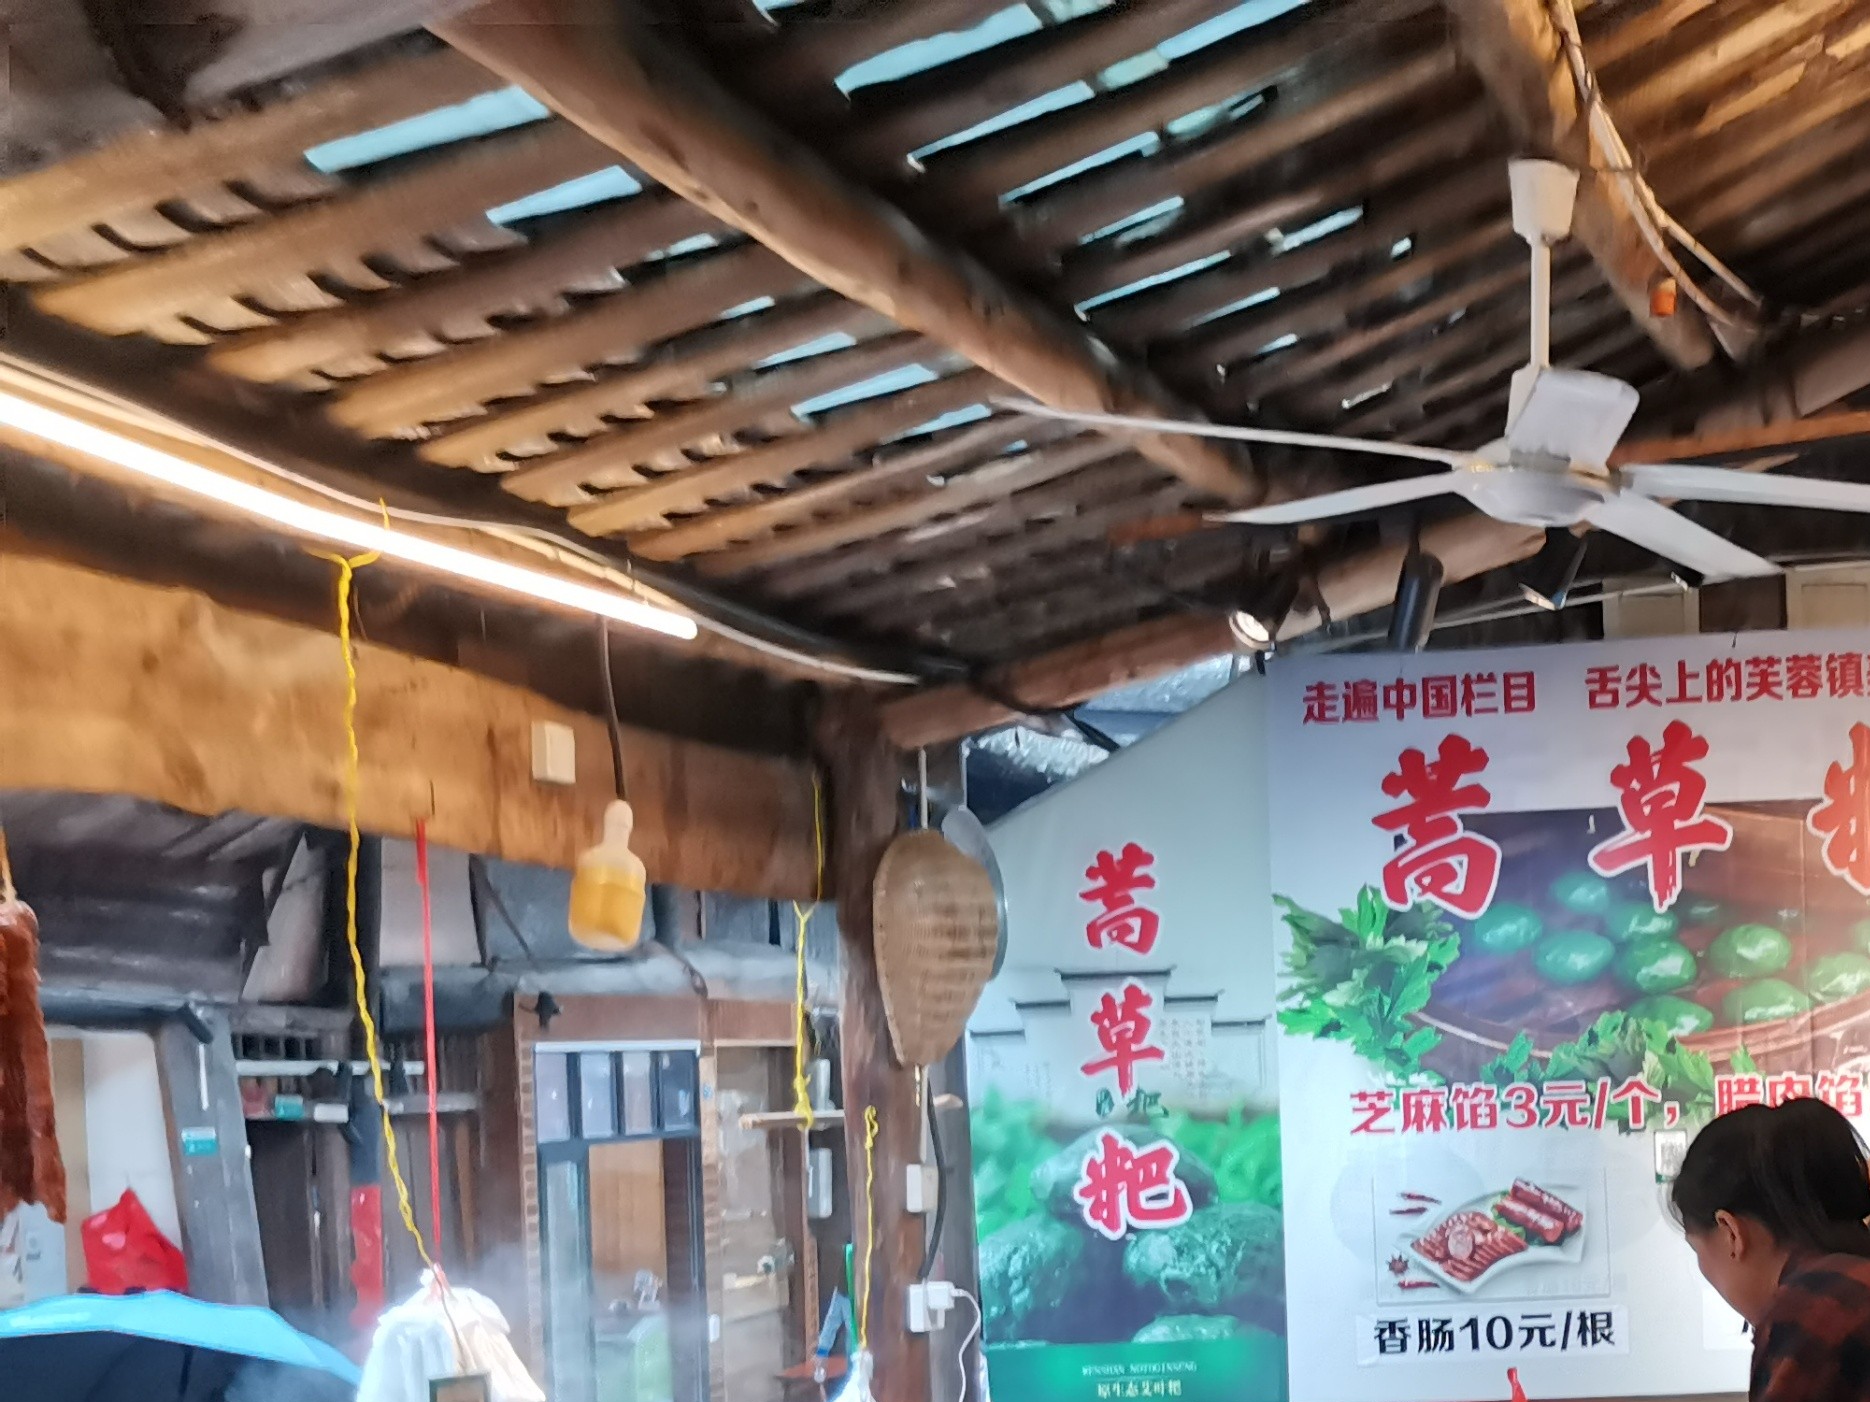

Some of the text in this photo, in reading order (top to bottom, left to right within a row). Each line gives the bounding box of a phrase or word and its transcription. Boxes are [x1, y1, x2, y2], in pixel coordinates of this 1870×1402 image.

[1302, 670, 1537, 726] 走遍中国栏目
[1080, 841, 1187, 1232] 蒿草粑
[1373, 1310, 1616, 1355] 香肠10元/根
